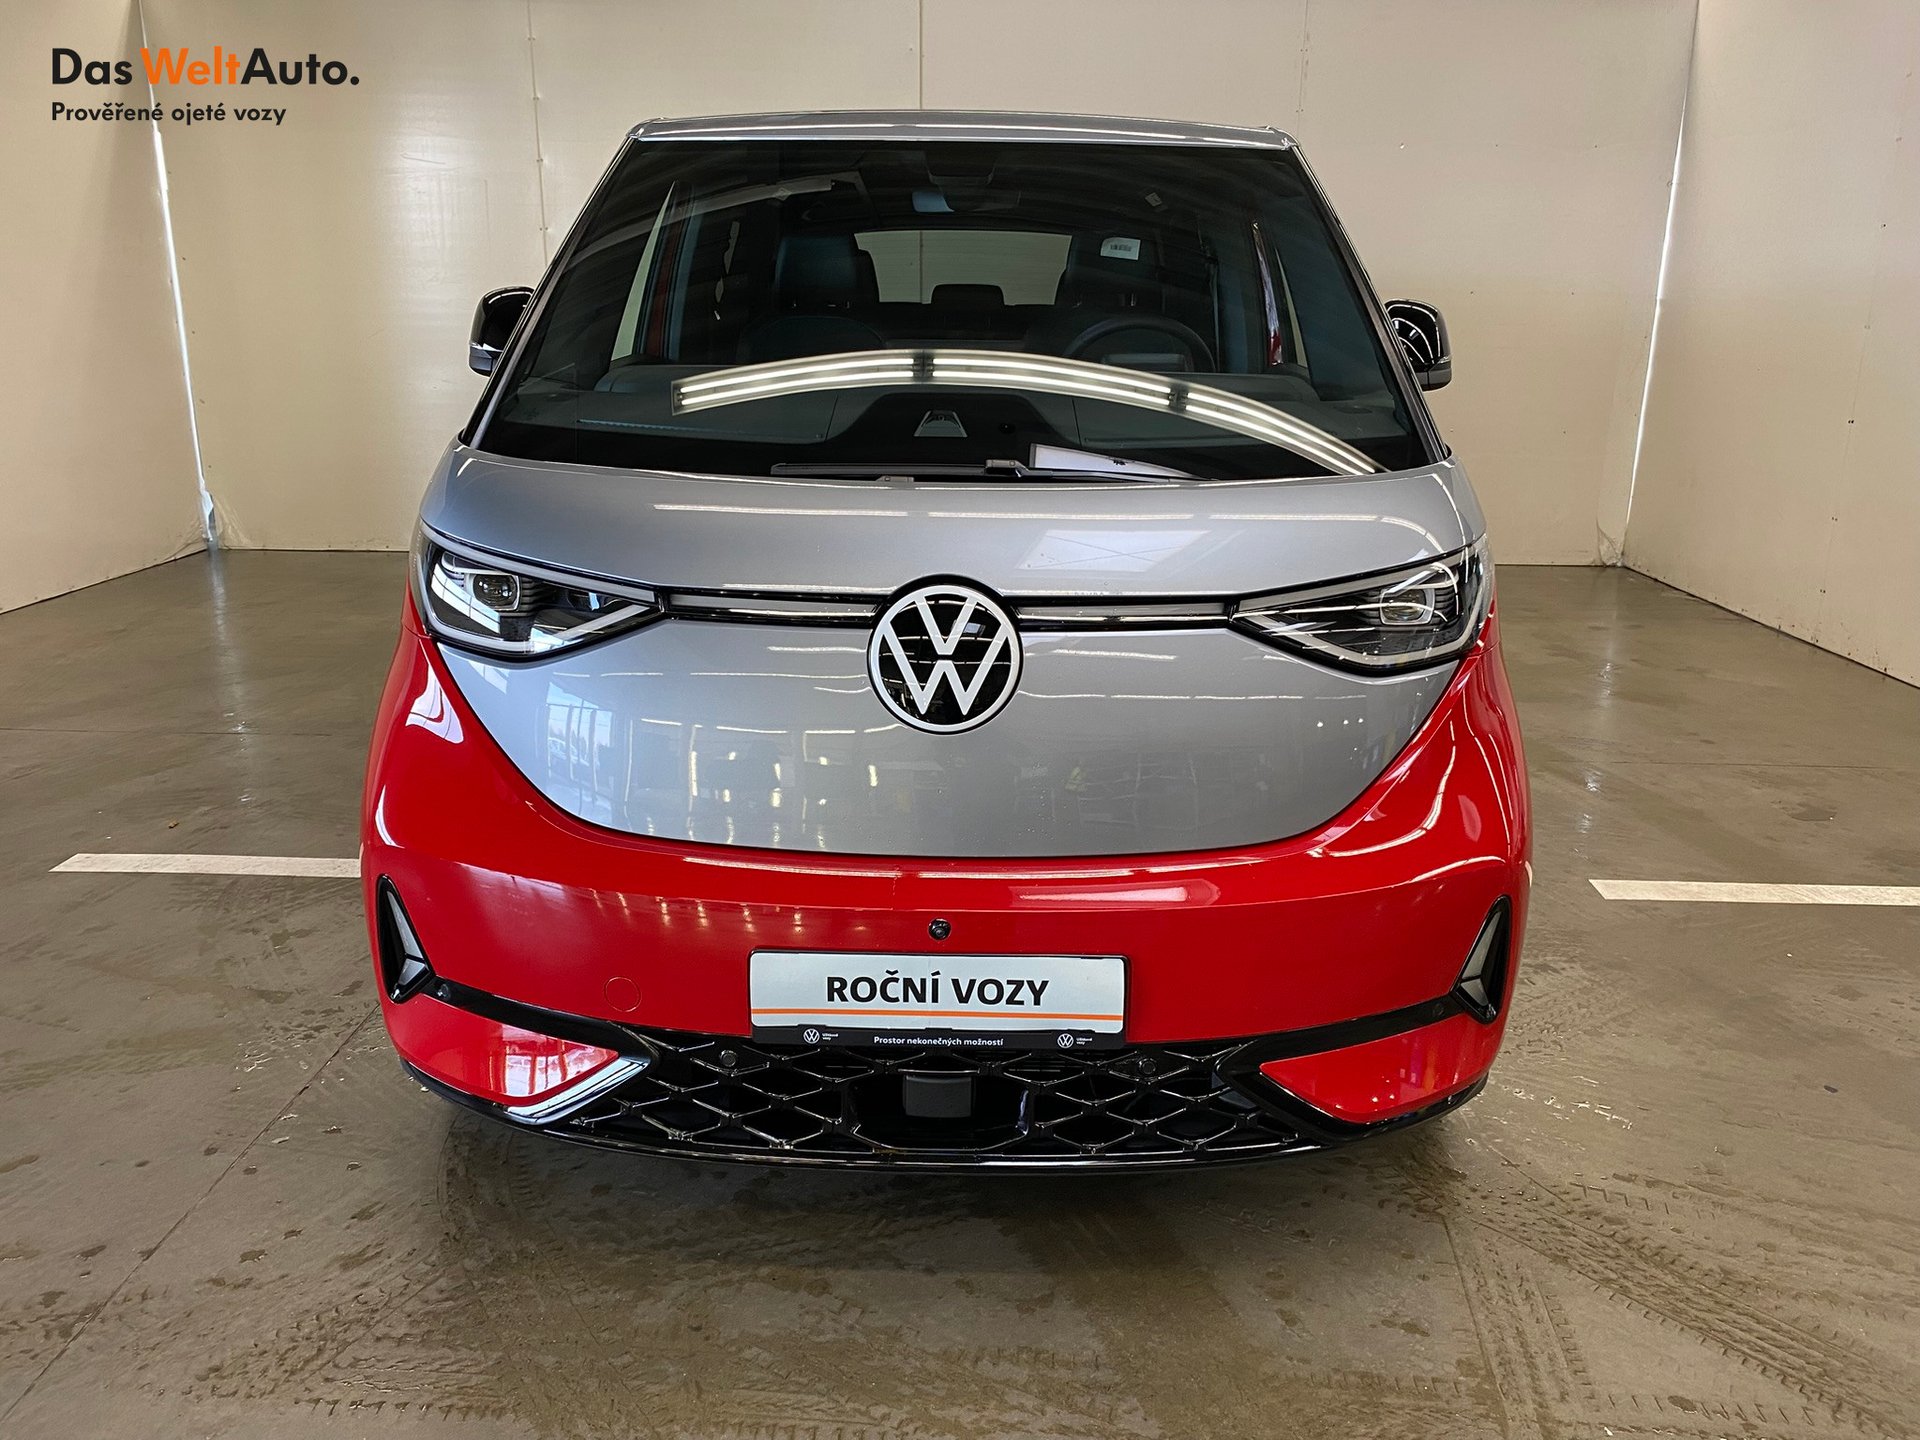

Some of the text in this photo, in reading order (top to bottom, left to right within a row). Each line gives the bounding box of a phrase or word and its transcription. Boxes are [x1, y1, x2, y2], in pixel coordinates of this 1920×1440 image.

[827, 969, 1049, 1006] ROČNÍ VOZY
[874, 1036, 1004, 1047] Prostor nekonečných možností
